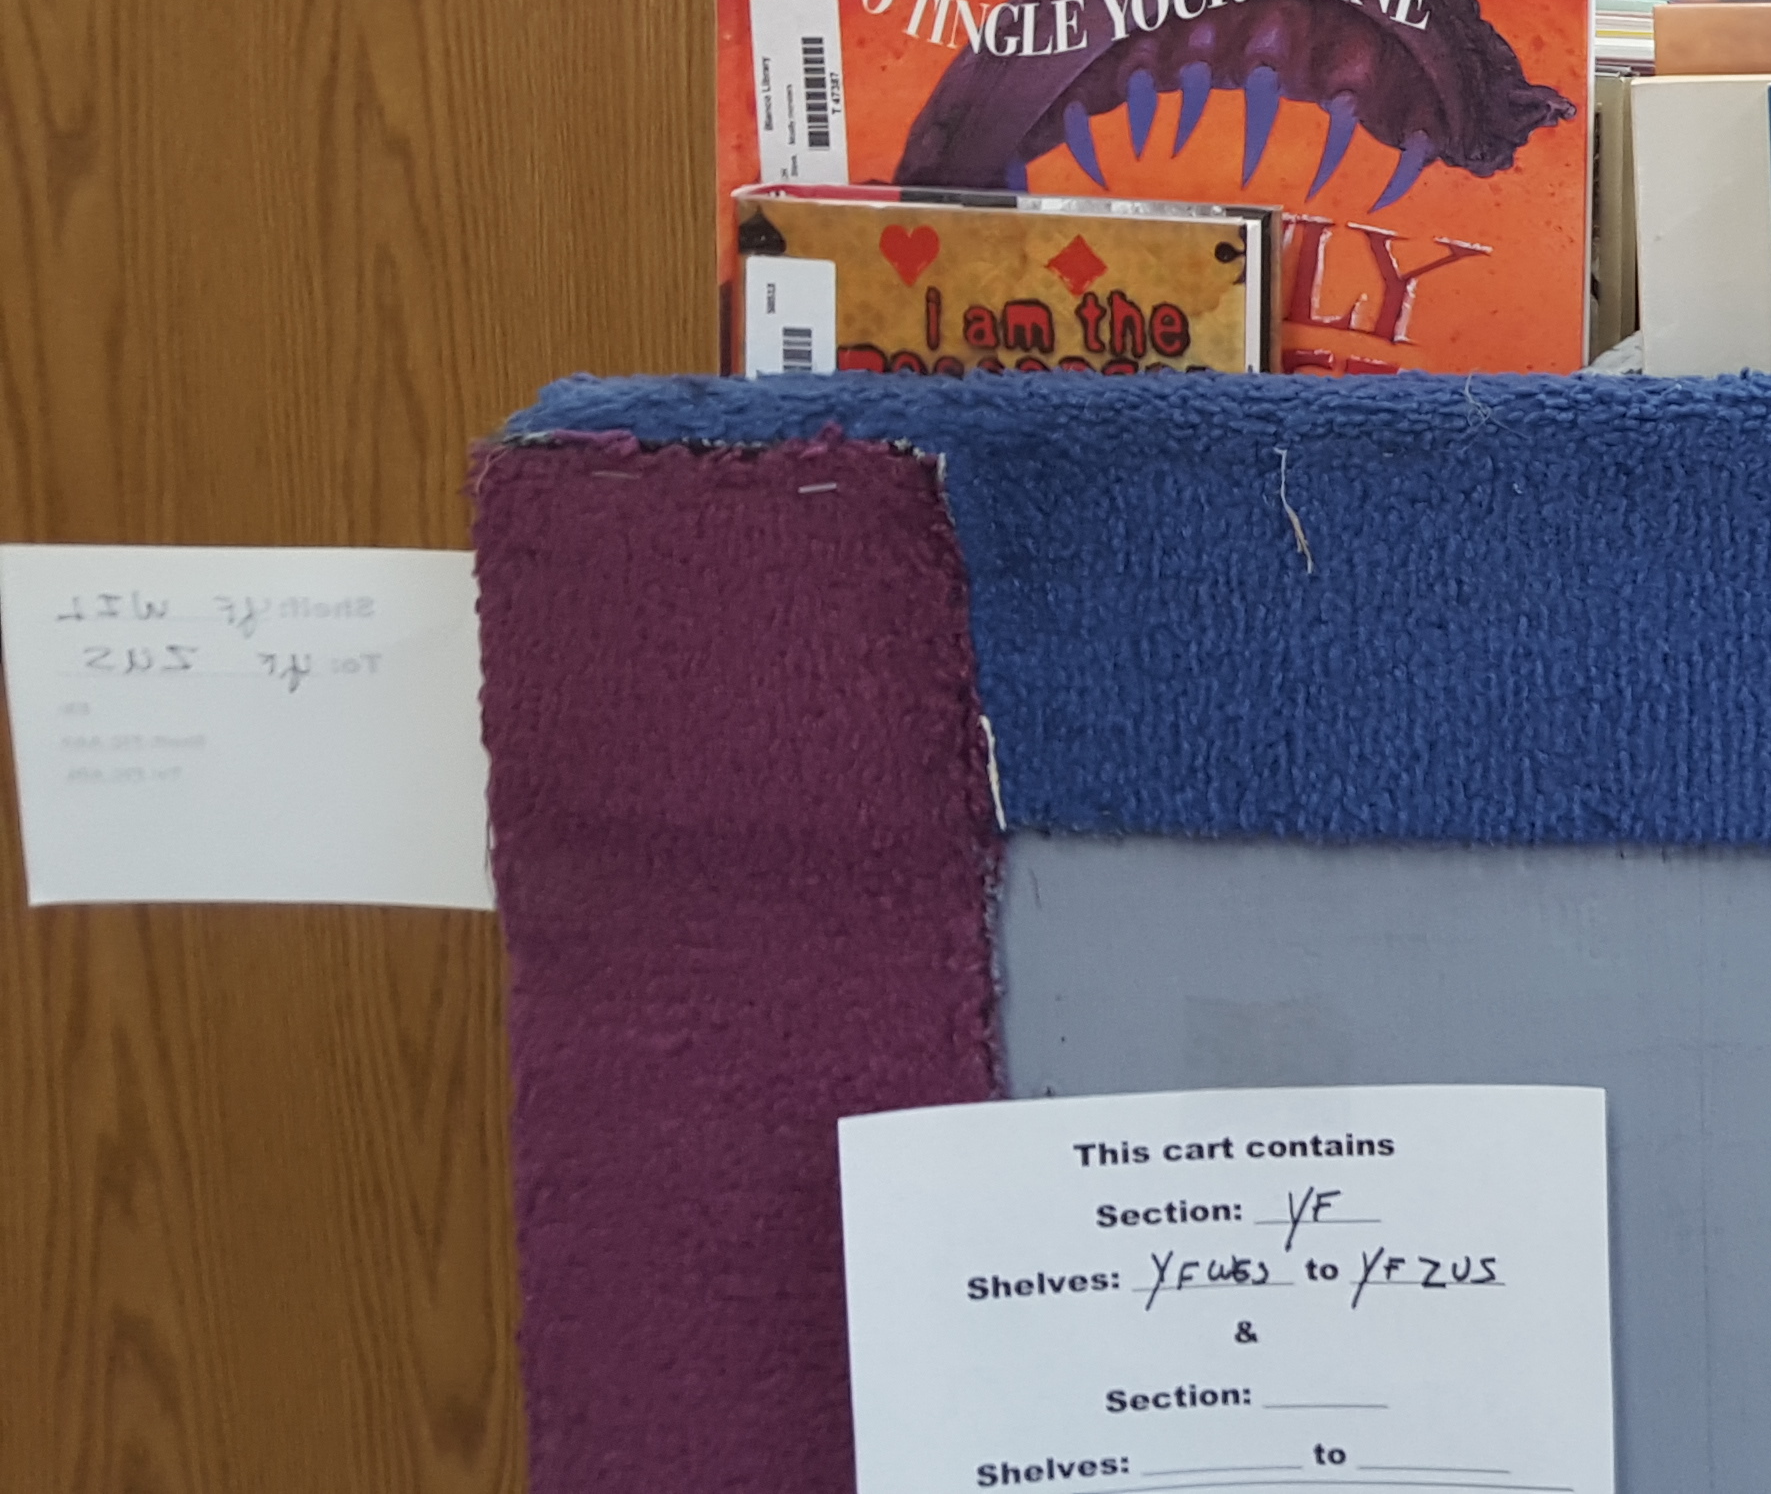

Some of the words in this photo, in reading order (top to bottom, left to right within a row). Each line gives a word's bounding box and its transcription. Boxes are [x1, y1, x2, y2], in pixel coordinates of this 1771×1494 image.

[962, 299, 1055, 354] am
[1074, 289, 1191, 358] the
[1073, 1140, 1151, 1167] This
[1162, 1136, 1235, 1161] cart
[1246, 1133, 1396, 1160] contains
[1096, 1200, 1243, 1229] Section:
[1284, 1186, 1342, 1252] YF
[966, 1270, 1121, 1301] Shelves:
[1305, 1258, 1340, 1282] to
[1418, 1255, 1500, 1289] ZUS
[1234, 1320, 1259, 1345] &
[1105, 1384, 1253, 1414] Section:
[976, 1454, 1131, 1489] Shelves:
[1313, 1443, 1347, 1468] to
